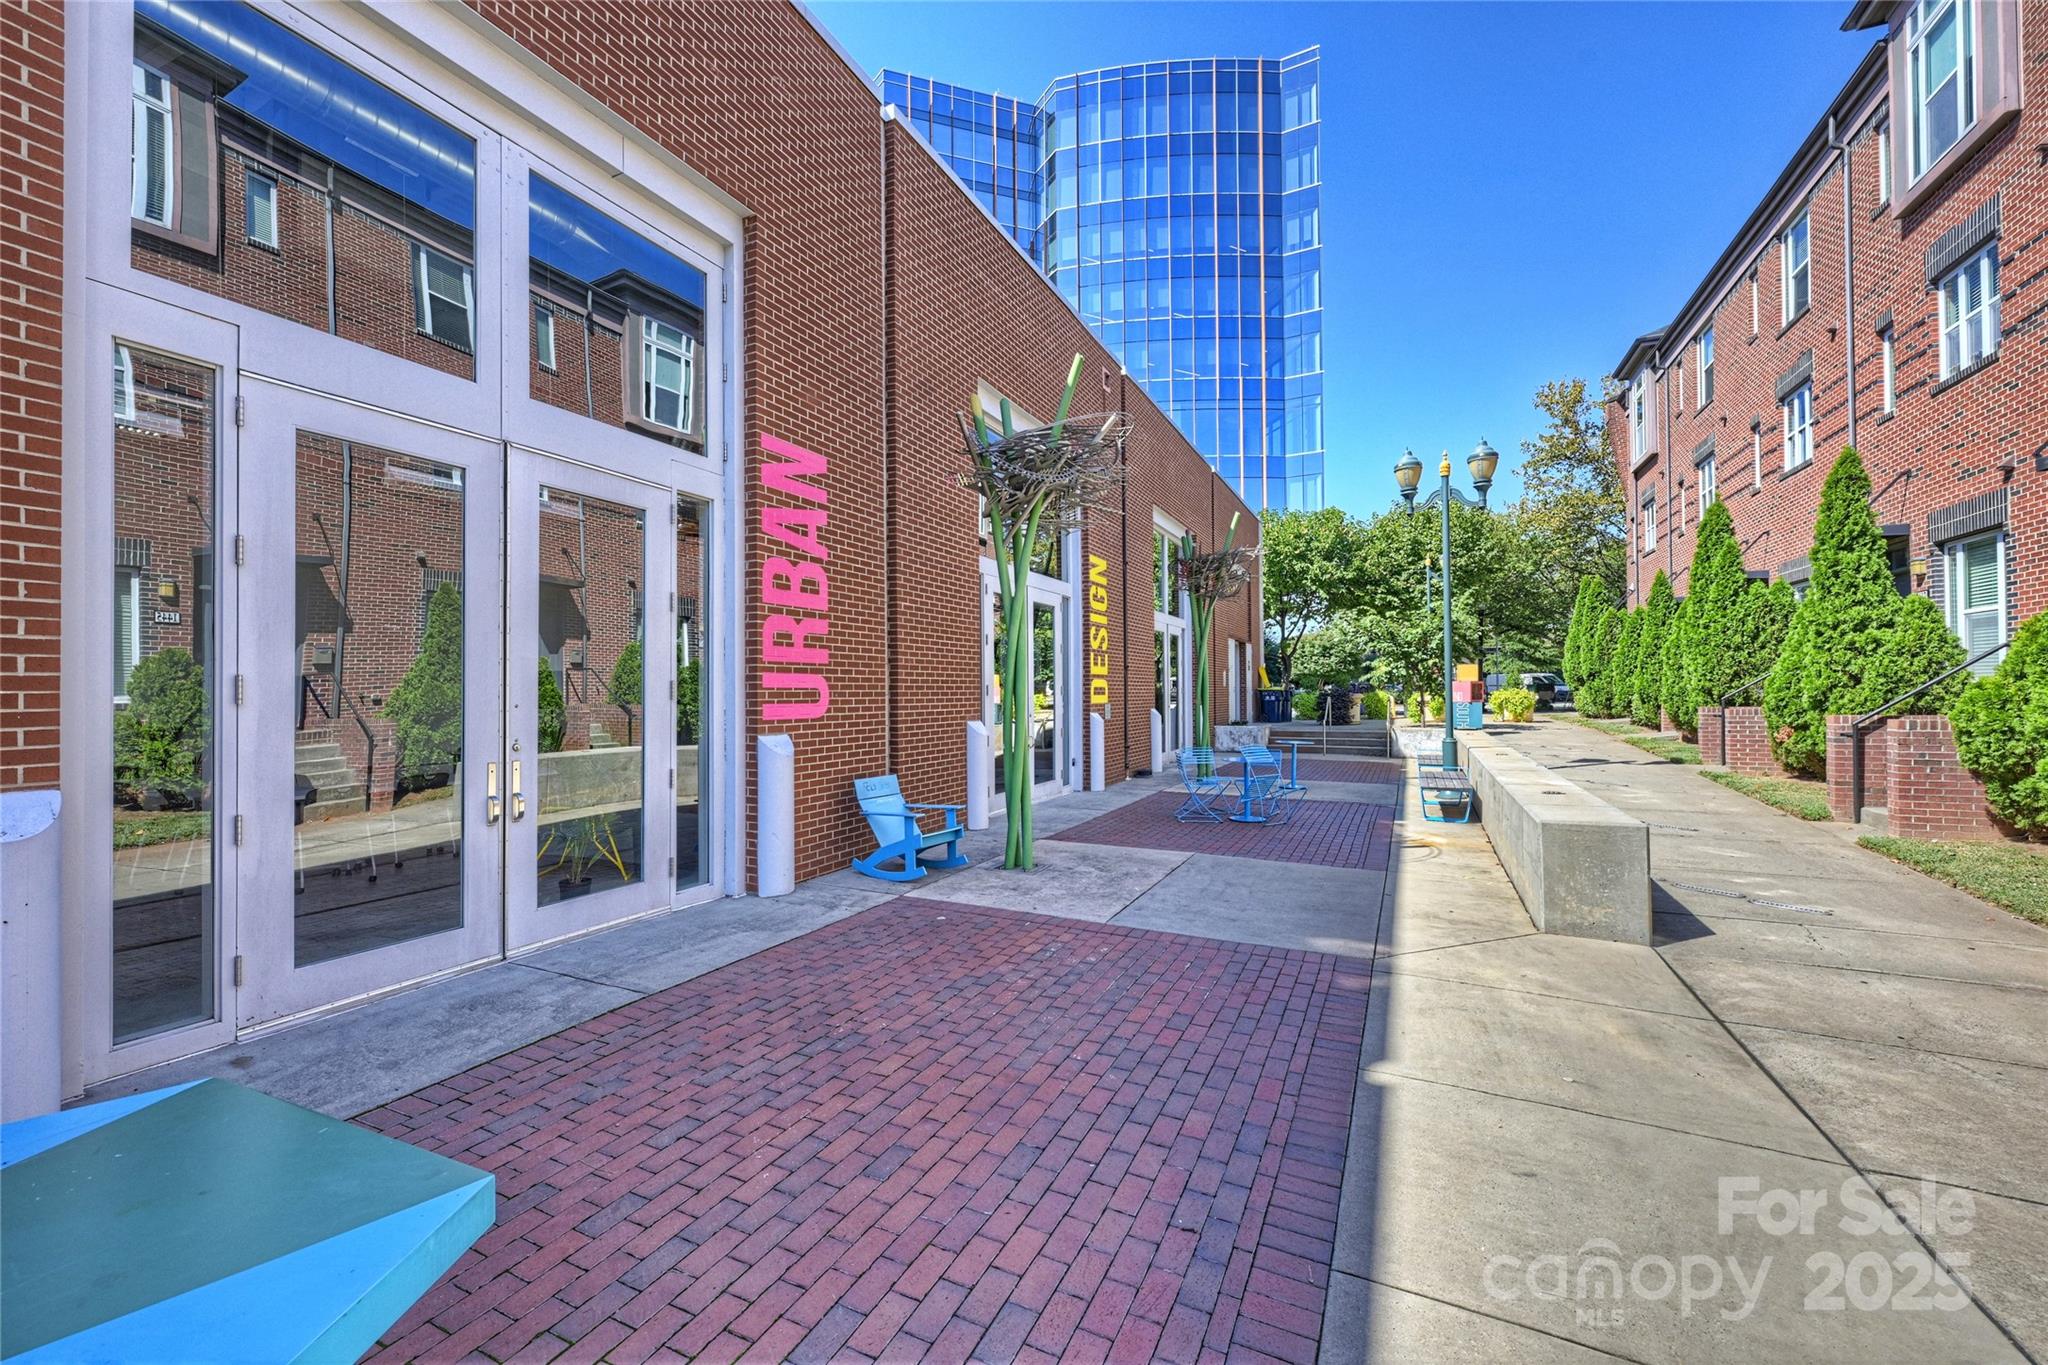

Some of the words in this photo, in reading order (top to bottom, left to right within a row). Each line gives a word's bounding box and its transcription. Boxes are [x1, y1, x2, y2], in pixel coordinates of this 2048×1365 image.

[760, 431, 830, 720] URBAN
[1088, 553, 1110, 705] DESIGN
[1456, 702, 1470, 728] SOUTH
